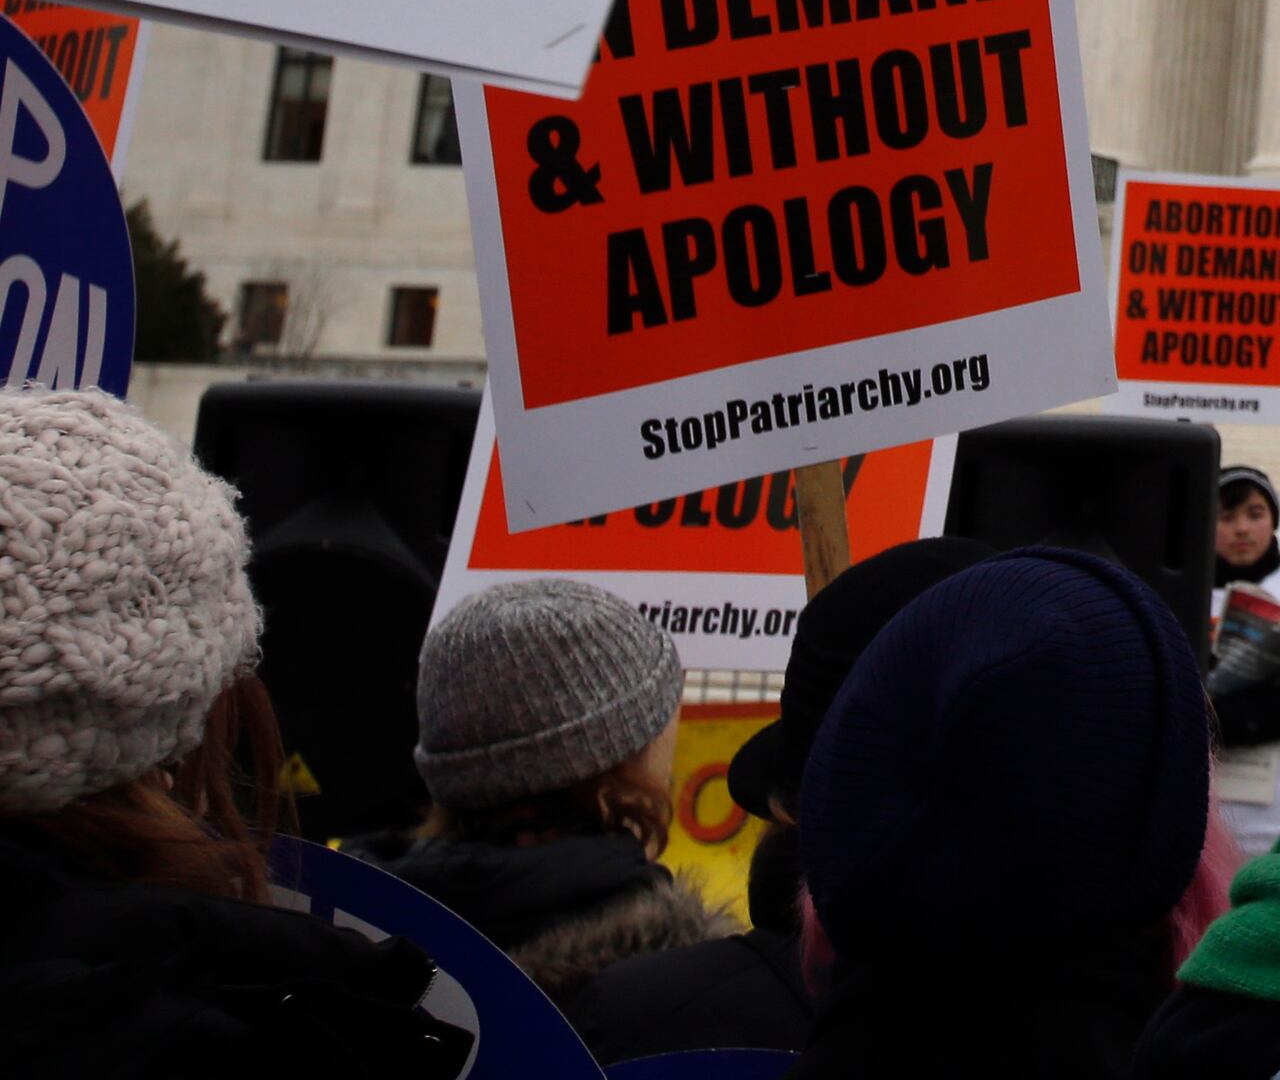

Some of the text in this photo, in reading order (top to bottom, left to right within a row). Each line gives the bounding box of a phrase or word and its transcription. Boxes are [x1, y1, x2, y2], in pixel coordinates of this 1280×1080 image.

[525, 28, 1032, 215] & WITHOUT
[607, 162, 994, 337] APOLOGY
[1129, 240, 1167, 276] ON
[1126, 288, 1148, 319] &
[1141, 330, 1274, 370] APOLOGY
[640, 353, 990, 460] StopPatriarchy.org
